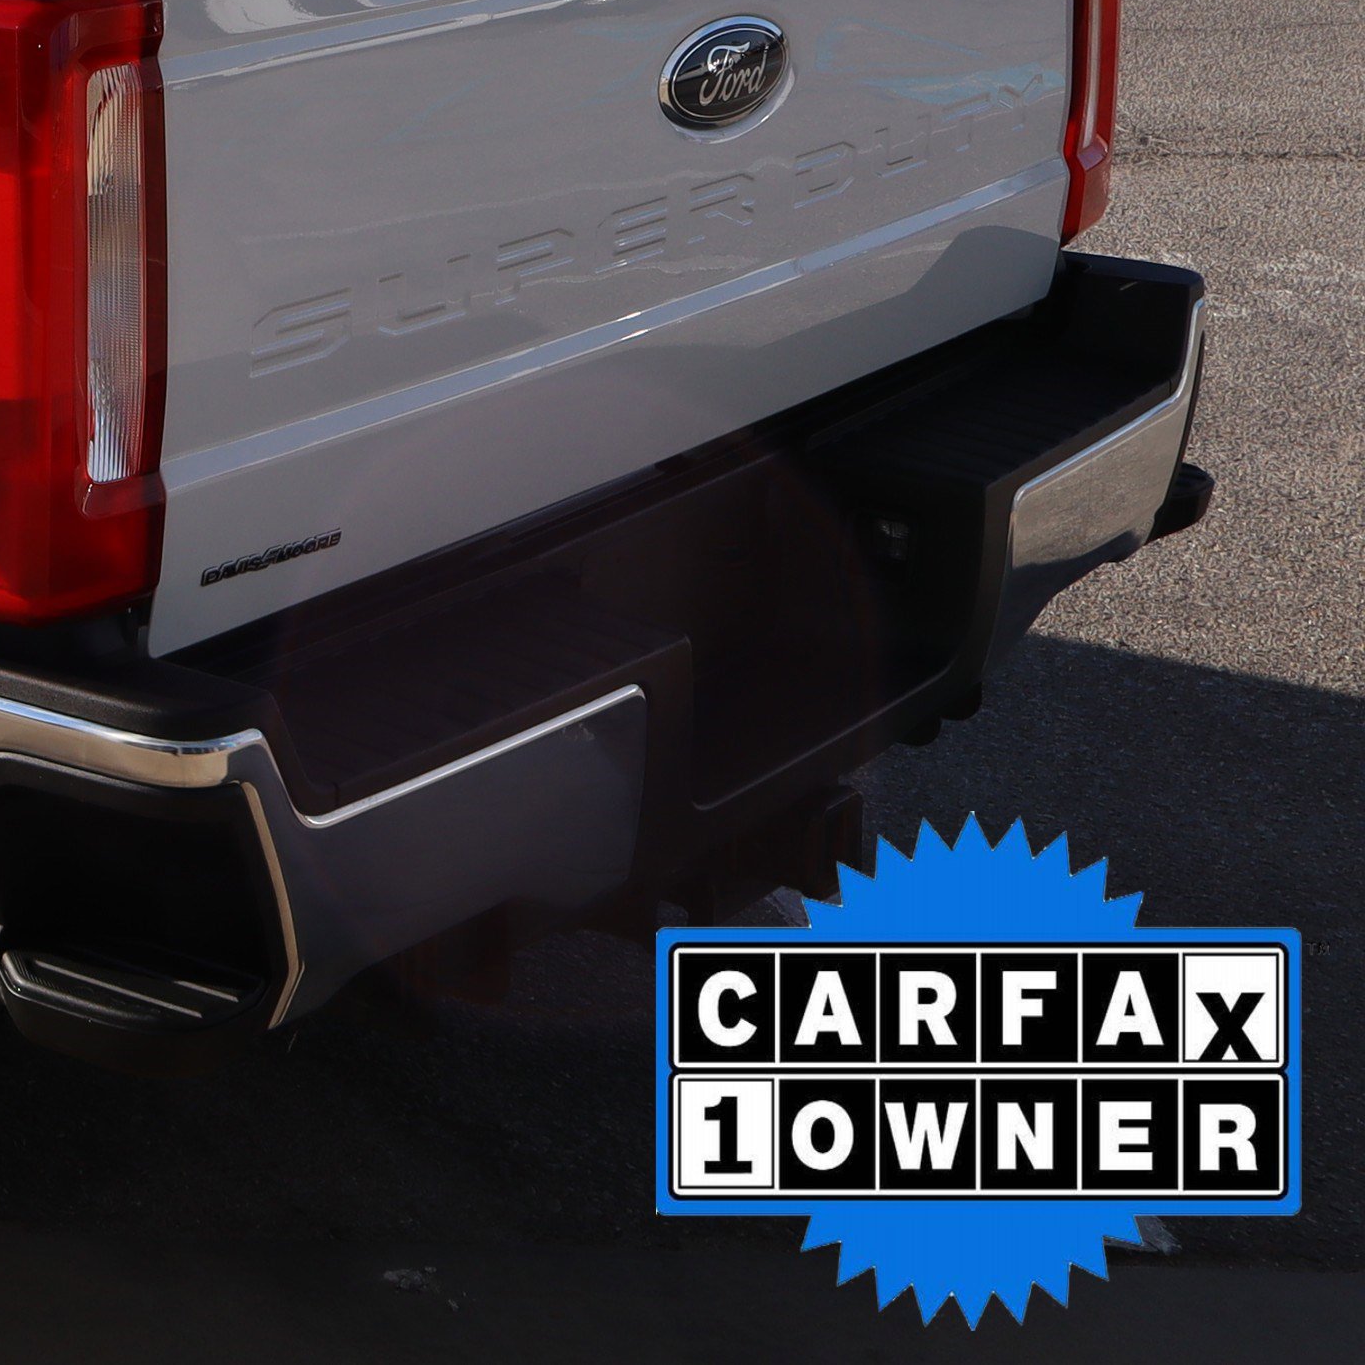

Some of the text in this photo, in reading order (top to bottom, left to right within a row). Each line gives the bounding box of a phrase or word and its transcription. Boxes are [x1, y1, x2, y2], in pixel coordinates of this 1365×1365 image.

[699, 41, 770, 107] Ford
[249, 73, 1046, 380] SUPER DUTY
